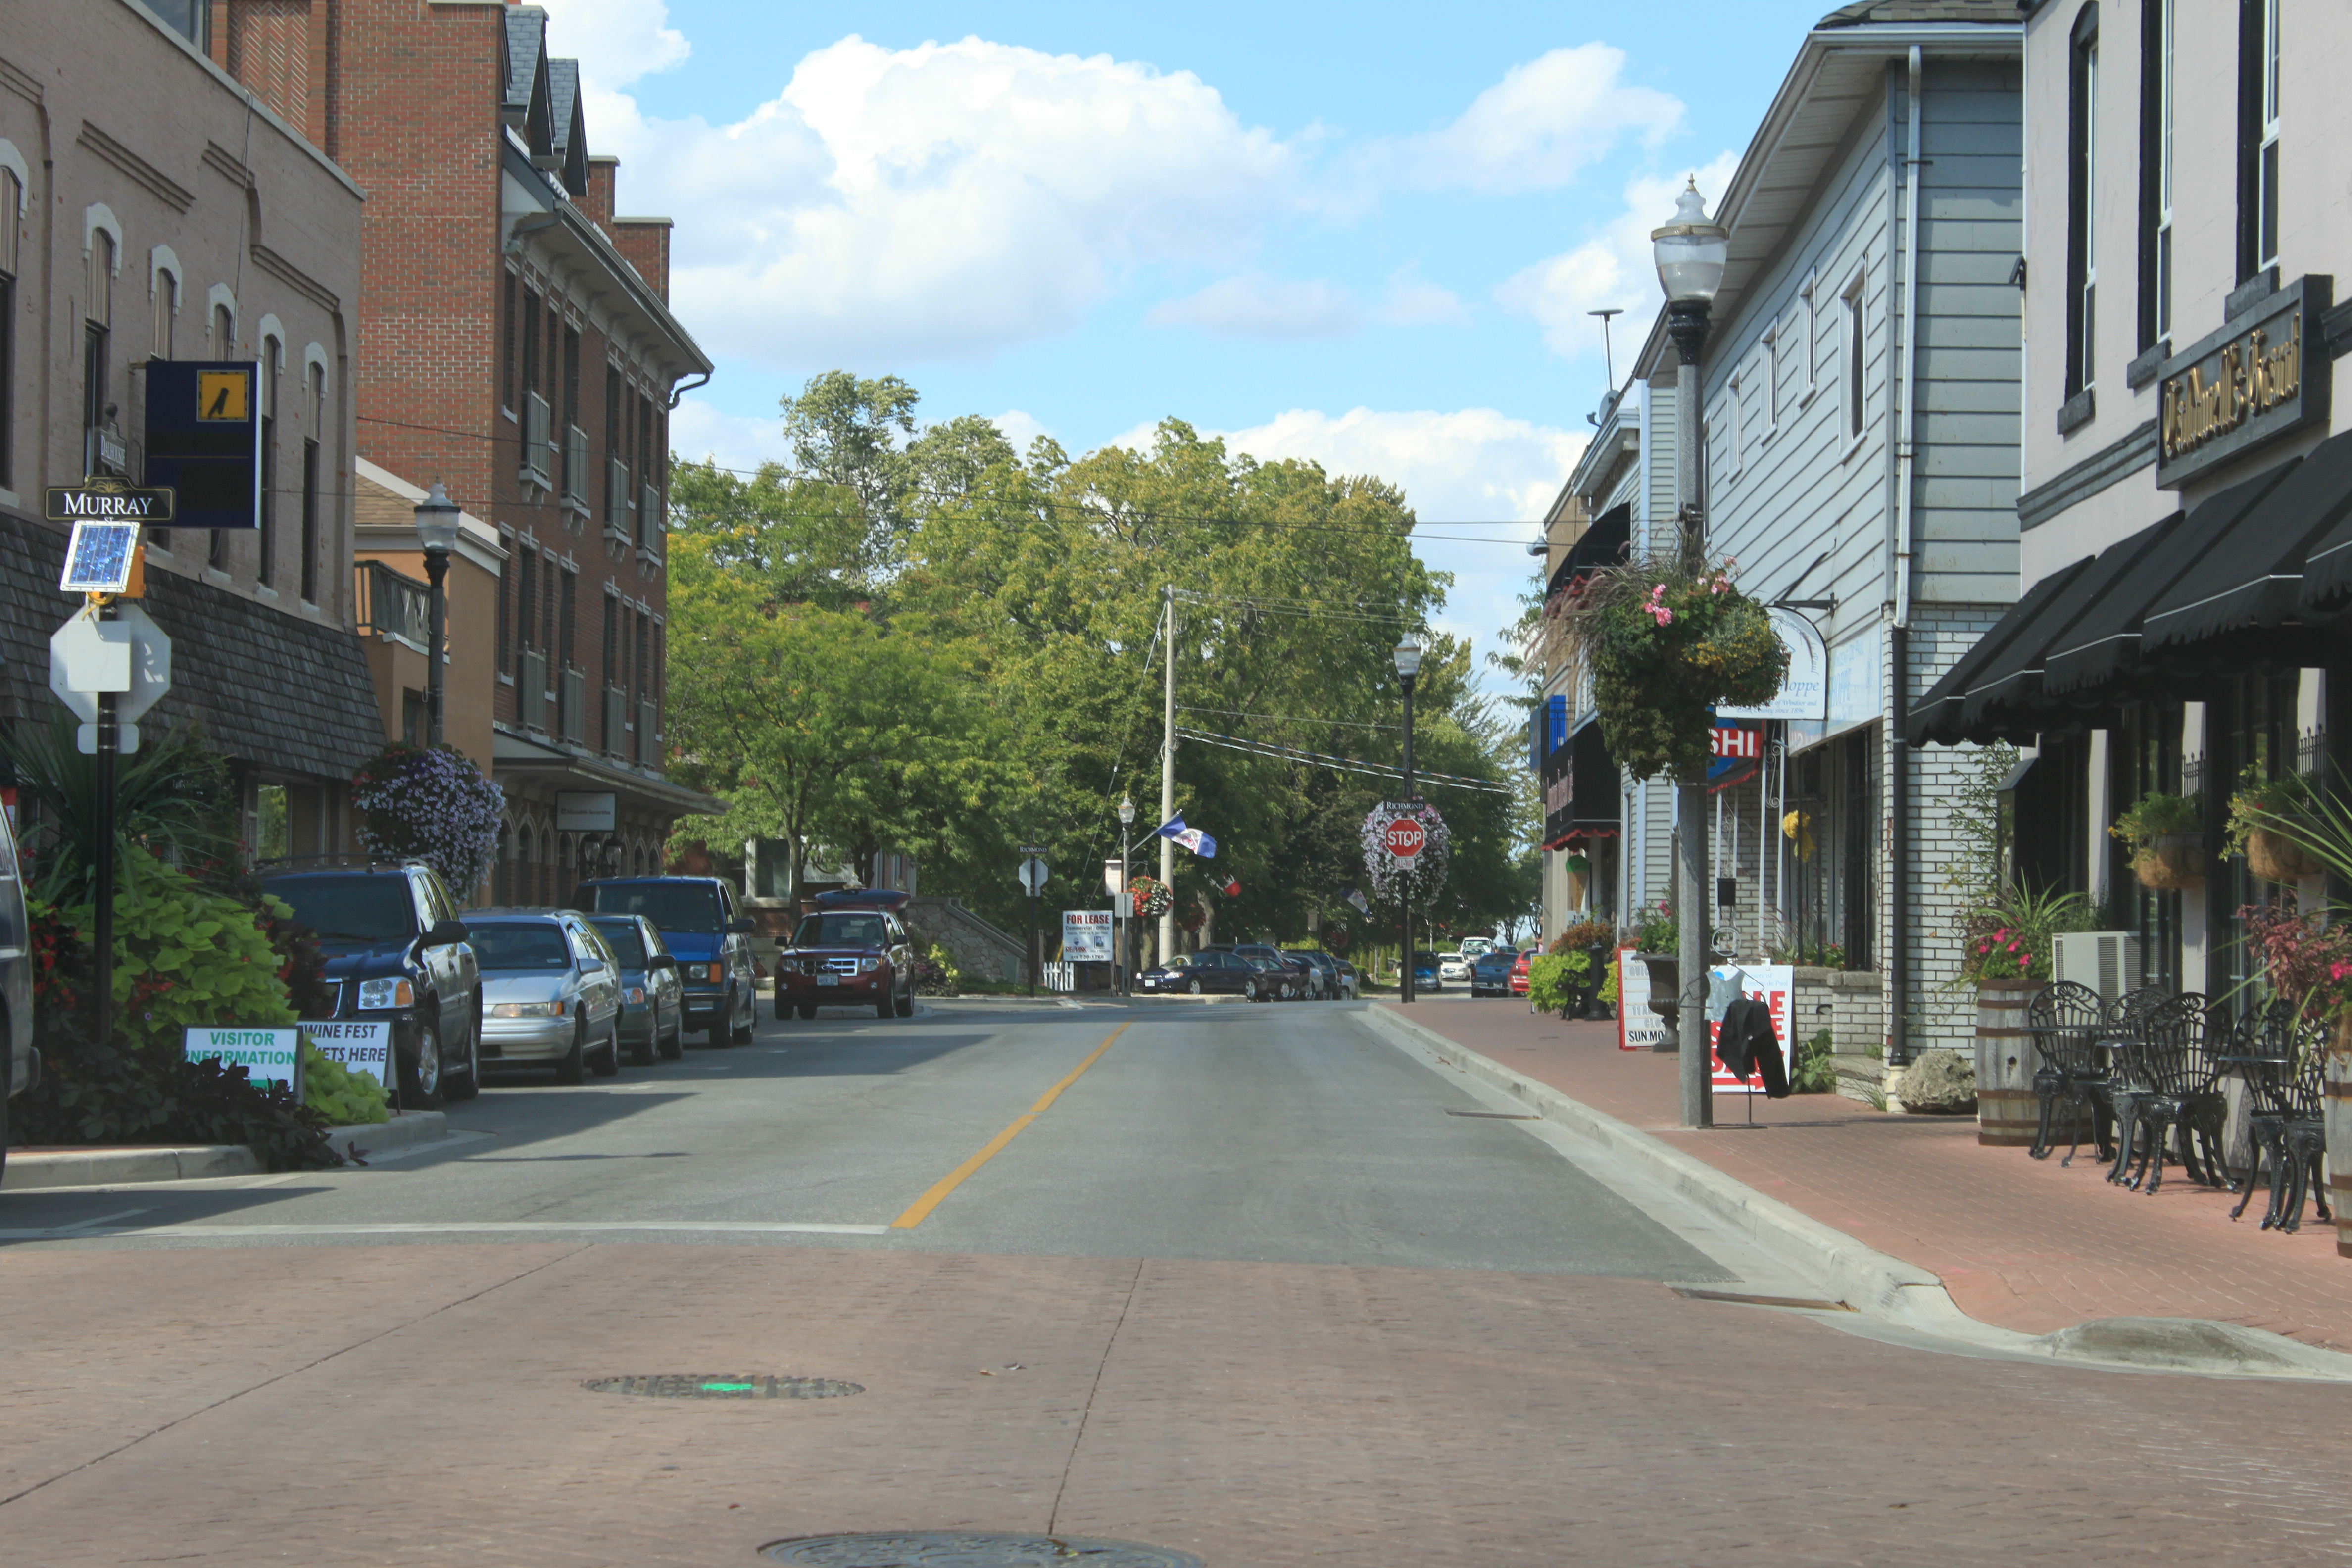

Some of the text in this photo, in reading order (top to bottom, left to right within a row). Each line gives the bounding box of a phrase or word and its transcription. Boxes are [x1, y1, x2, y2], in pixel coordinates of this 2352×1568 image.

[63, 493, 153, 515] MURRAY
[1387, 801, 1424, 810] RICHMOND
[1387, 831, 1422, 847] STOP
[1067, 915, 1109, 924] FOR LEASE
[1629, 966, 1650, 977] QUIC
[210, 1032, 275, 1046] VISITOR
[344, 1025, 378, 1039] FEST
[348, 1047, 386, 1062] HERE
